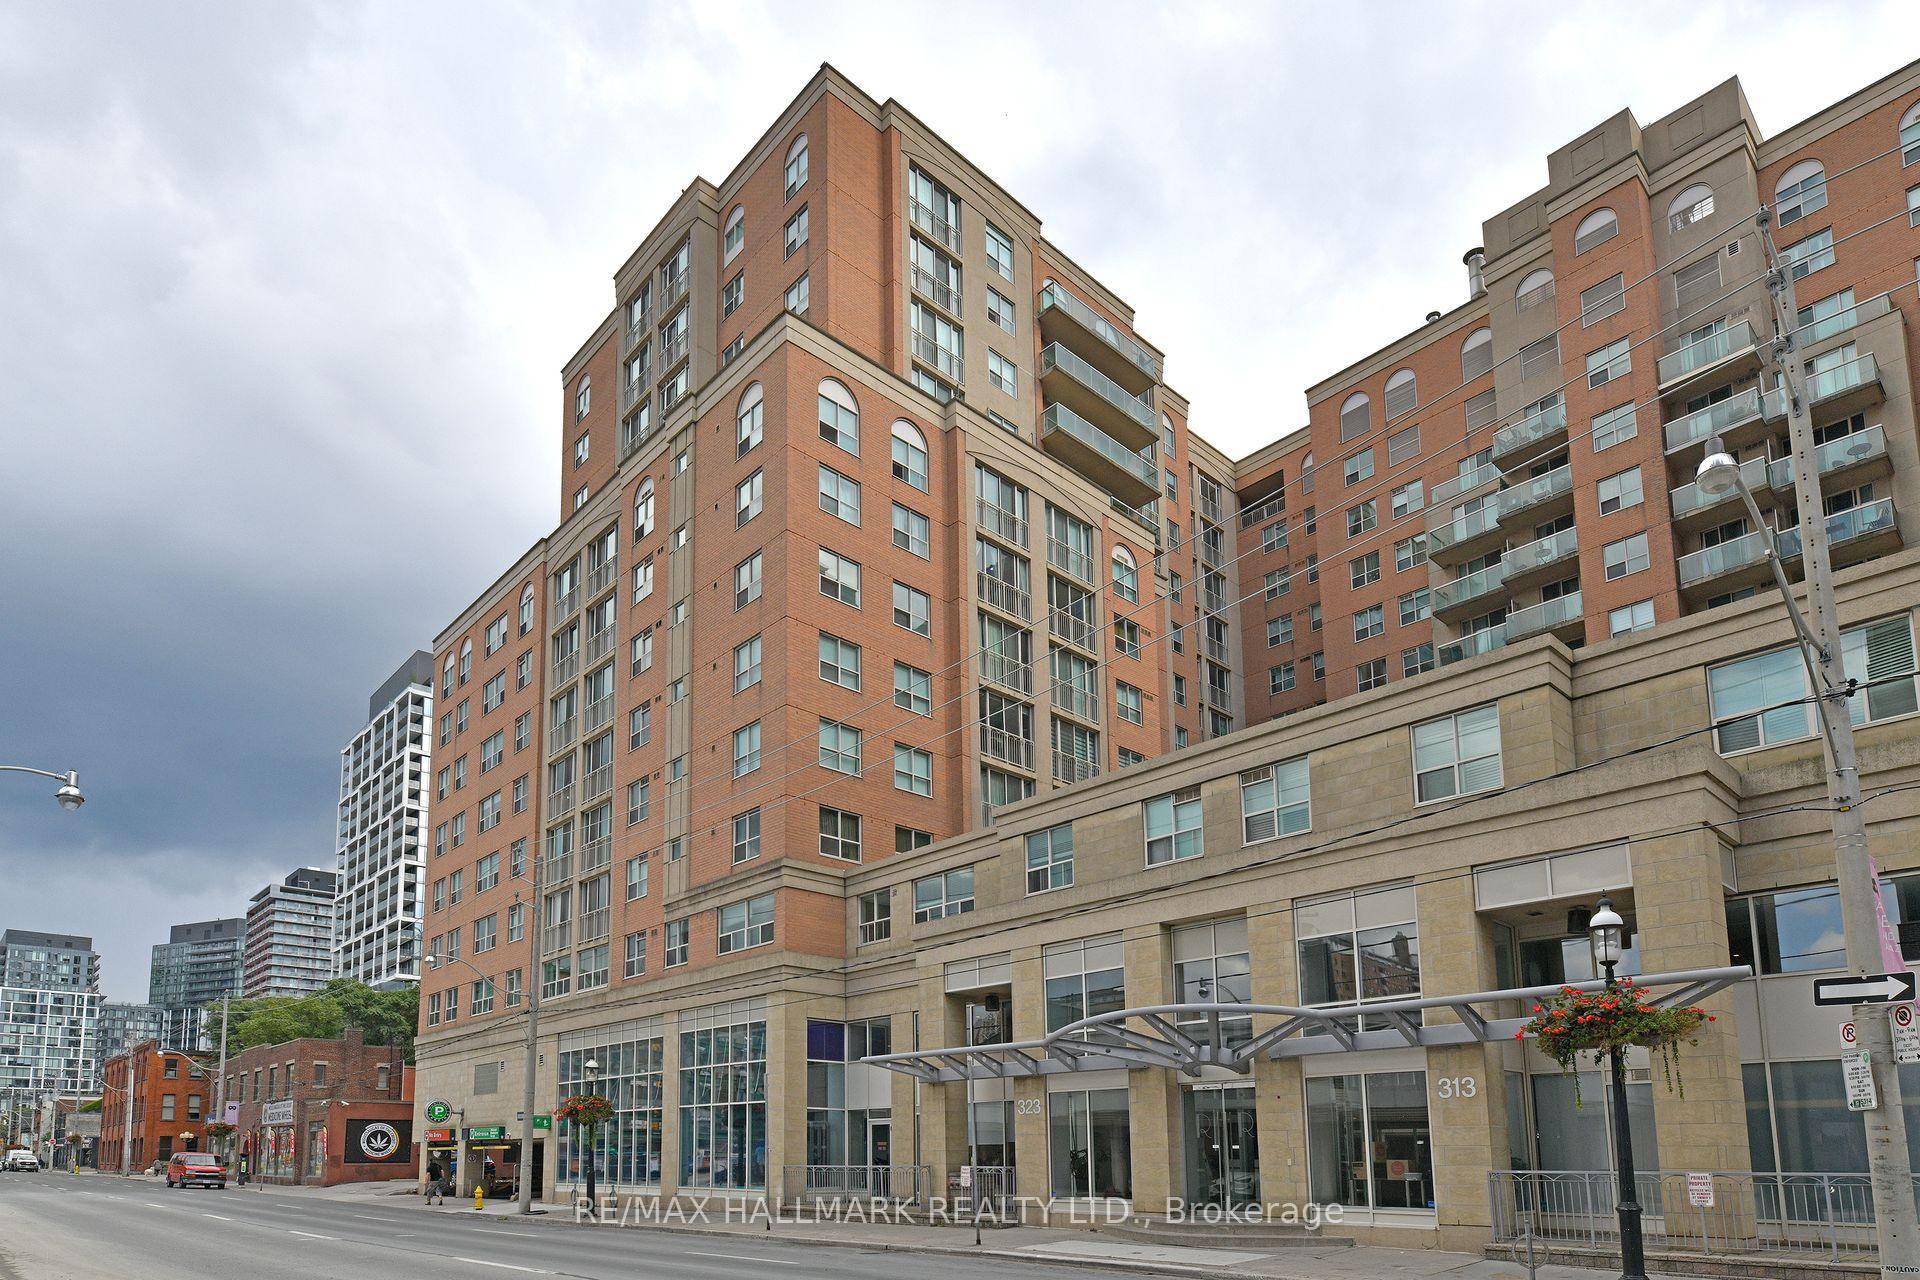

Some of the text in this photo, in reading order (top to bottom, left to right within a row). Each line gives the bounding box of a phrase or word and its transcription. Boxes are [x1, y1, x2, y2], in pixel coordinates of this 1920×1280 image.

[1438, 1076, 1477, 1099] 313
[1017, 1098, 1041, 1115] 323
[1885, 1265, 1920, 1273] CAUTION
